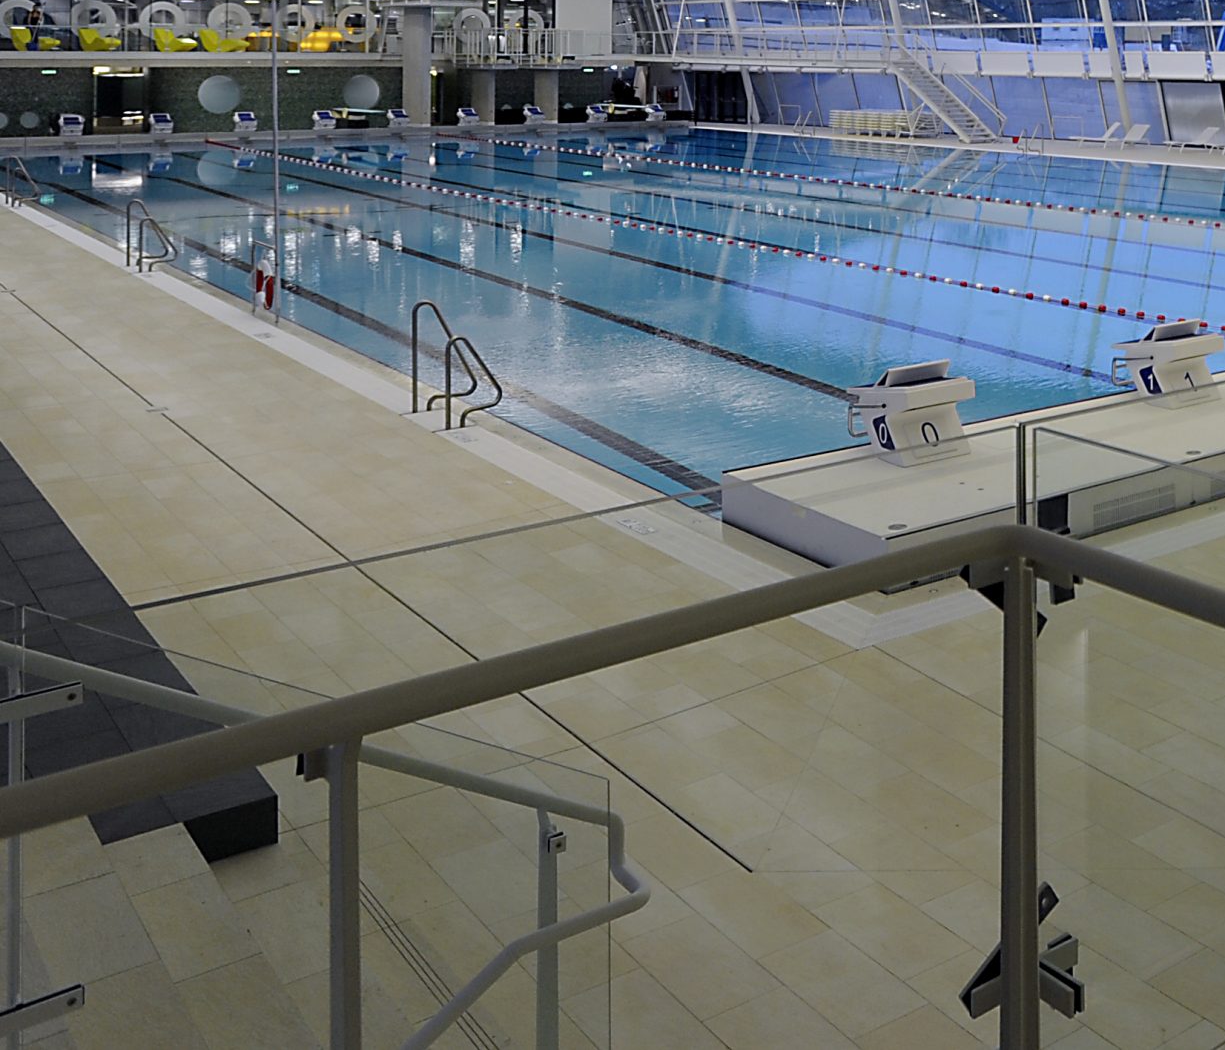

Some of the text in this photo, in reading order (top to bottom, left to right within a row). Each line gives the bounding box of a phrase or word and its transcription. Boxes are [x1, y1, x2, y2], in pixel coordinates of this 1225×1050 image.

[1147, 373, 1154, 391] 1
[1184, 371, 1198, 392] 1
[878, 423, 888, 444] 0
[921, 422, 940, 447] 0
